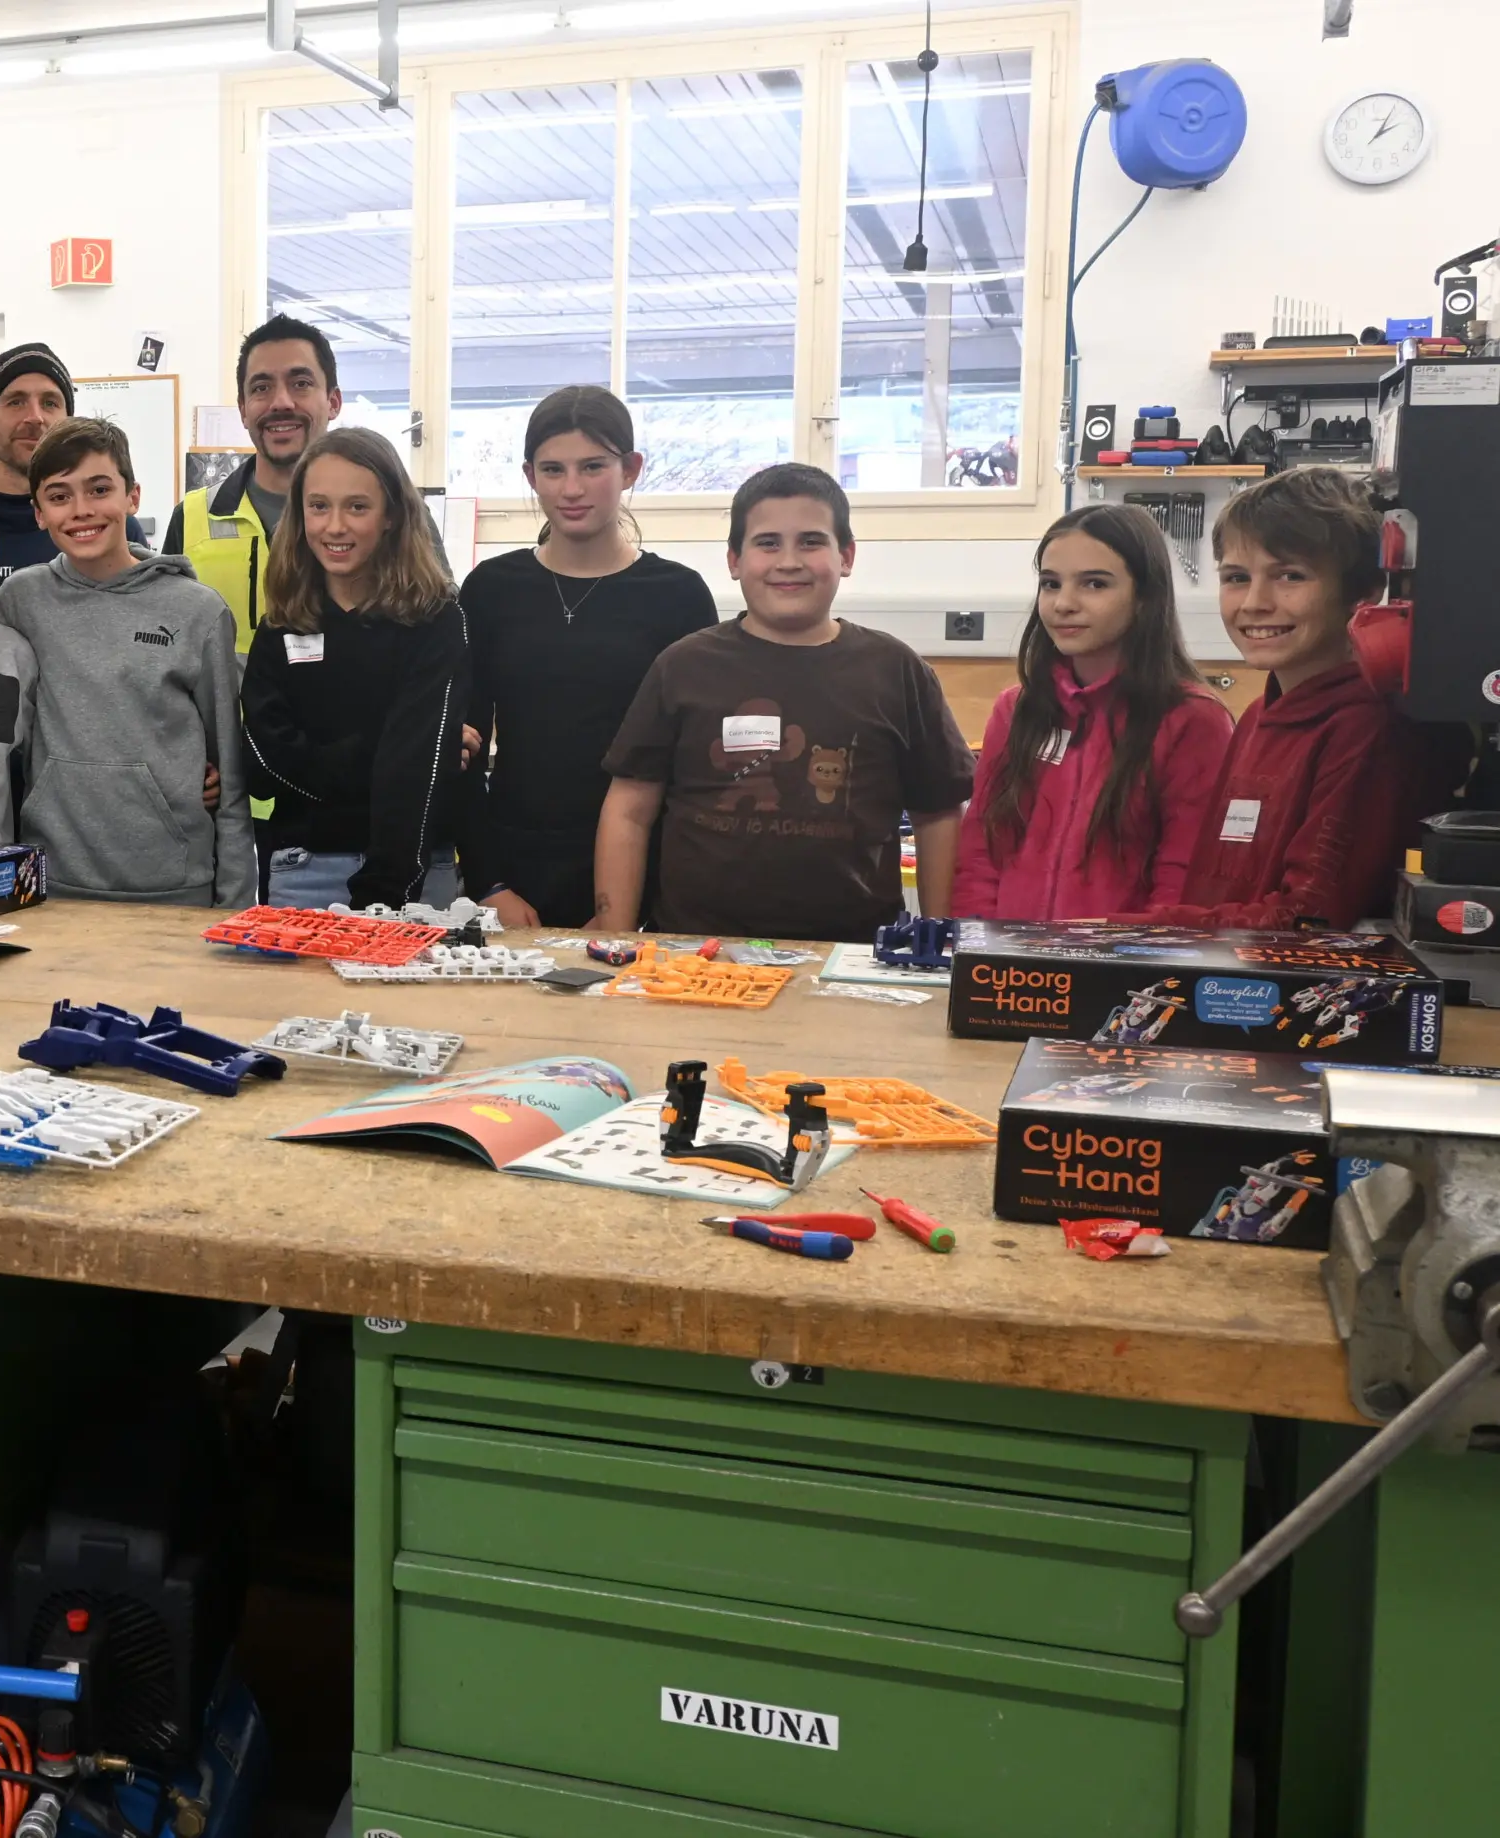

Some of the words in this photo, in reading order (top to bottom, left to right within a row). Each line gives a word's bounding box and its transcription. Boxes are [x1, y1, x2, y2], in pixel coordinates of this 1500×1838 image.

[1165, 466, 1173, 475] 2
[134, 632, 169, 647] PUMA
[971, 964, 1072, 994] Cyborg
[1202, 981, 1273, 1001] Beweglich!
[1420, 994, 1437, 1053] KOSMOS
[1043, 1044, 1257, 1065] Cyborg
[1023, 1124, 1162, 1168] Cyborg
[1020, 1196, 1048, 1206] Deine
[803, 1366, 812, 1380] 2
[668, 1692, 831, 1746] VARUNA
